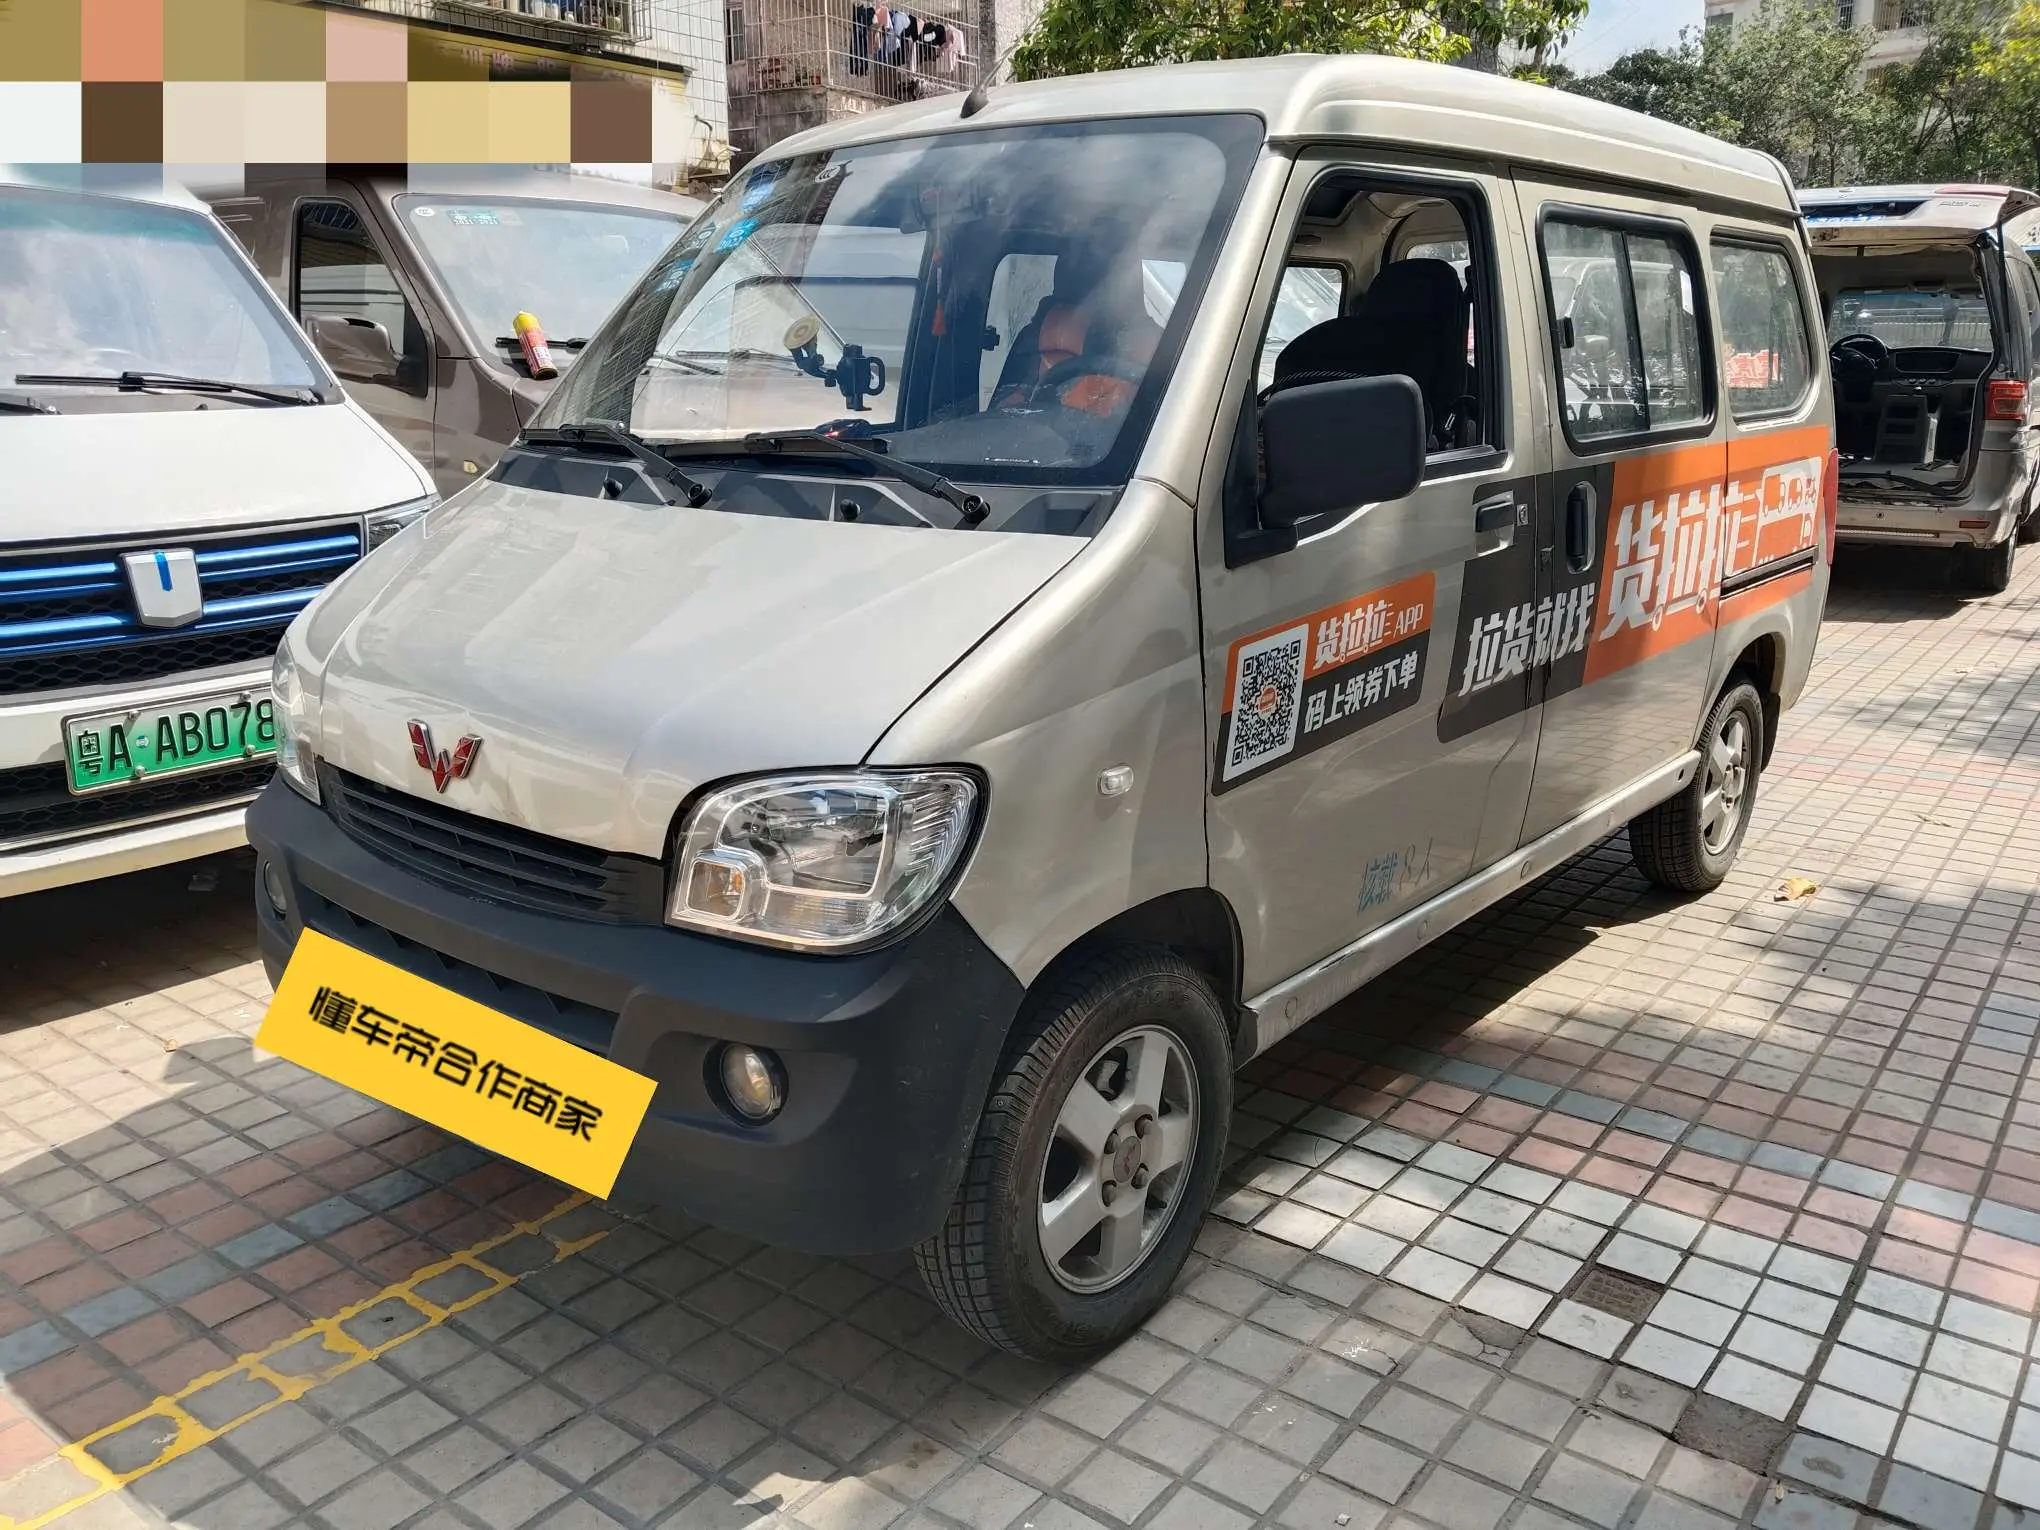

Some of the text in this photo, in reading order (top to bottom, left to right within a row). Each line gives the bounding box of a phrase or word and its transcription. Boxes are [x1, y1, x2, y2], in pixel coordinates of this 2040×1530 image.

[1458, 480, 1746, 697] 拉货就找 货拉拉
[1312, 600, 1424, 670] 货拉拉 APP
[1304, 651, 1418, 734] 码上领券下单
